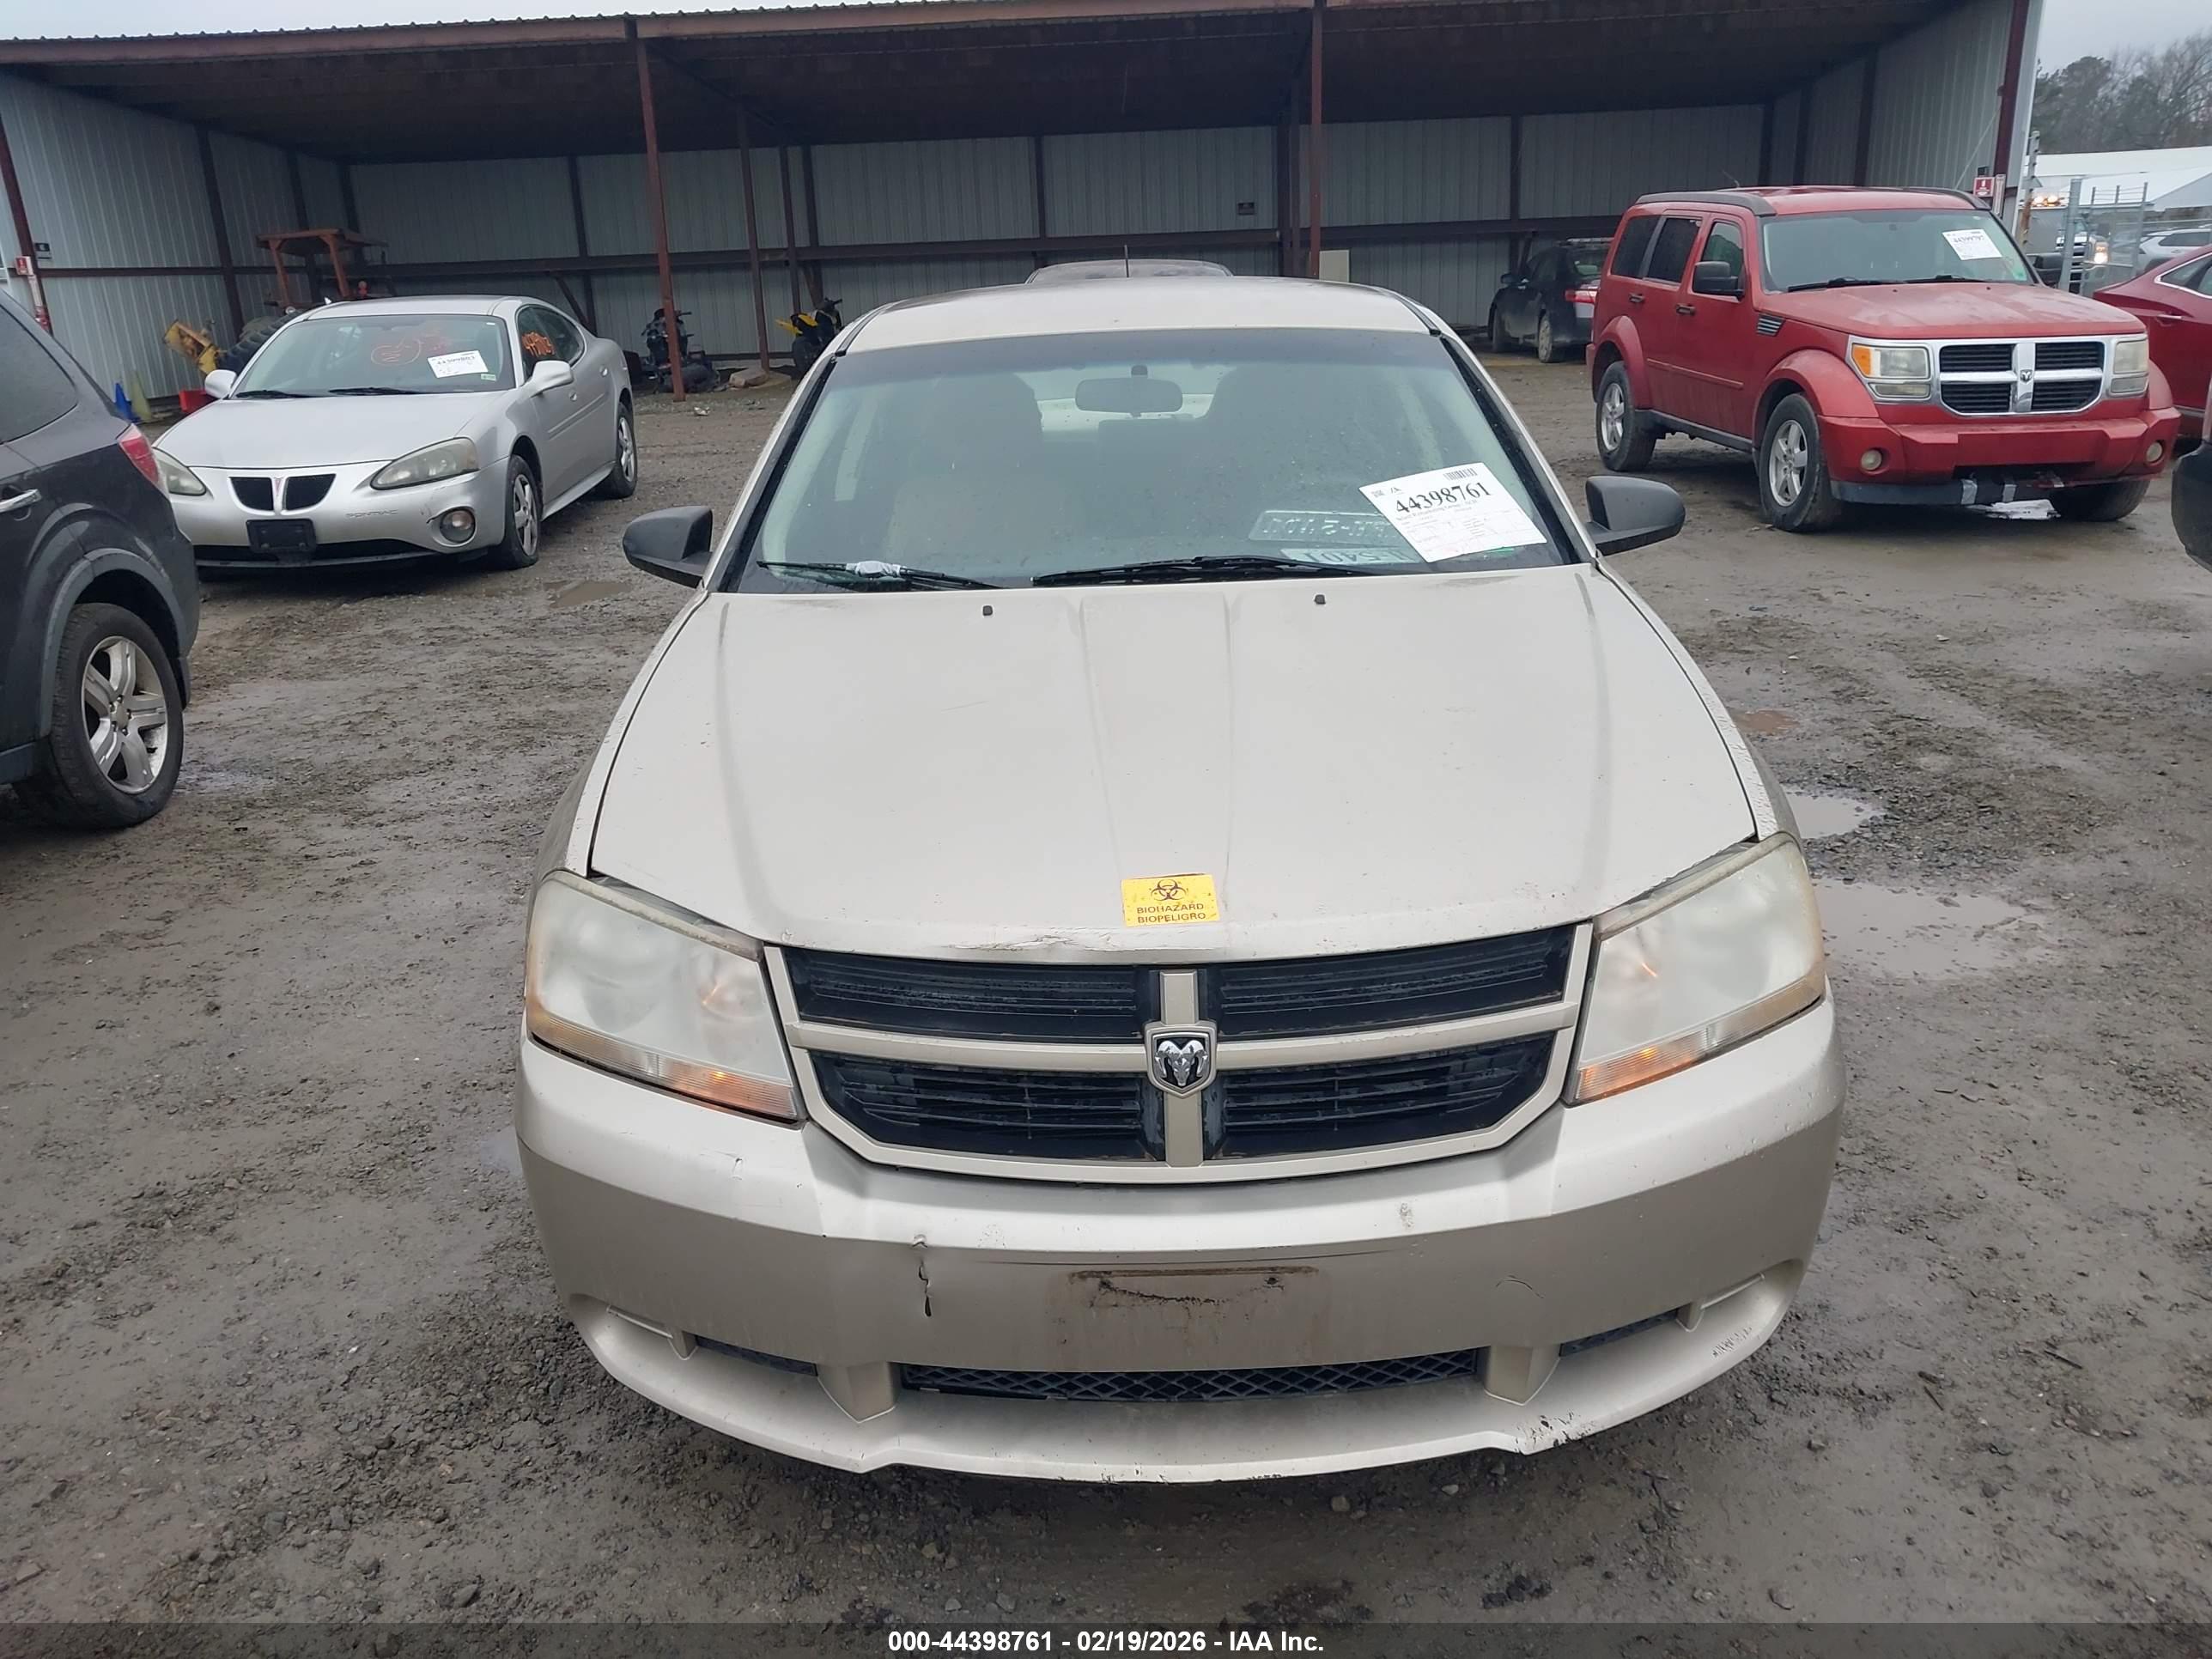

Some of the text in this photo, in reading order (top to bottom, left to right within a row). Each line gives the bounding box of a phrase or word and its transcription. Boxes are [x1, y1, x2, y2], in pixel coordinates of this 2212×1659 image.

[1396, 482, 1491, 513] 44398761
[1137, 903, 1204, 915] BIOHAZARD
[1138, 912, 1206, 923] BIOPELIGRO
